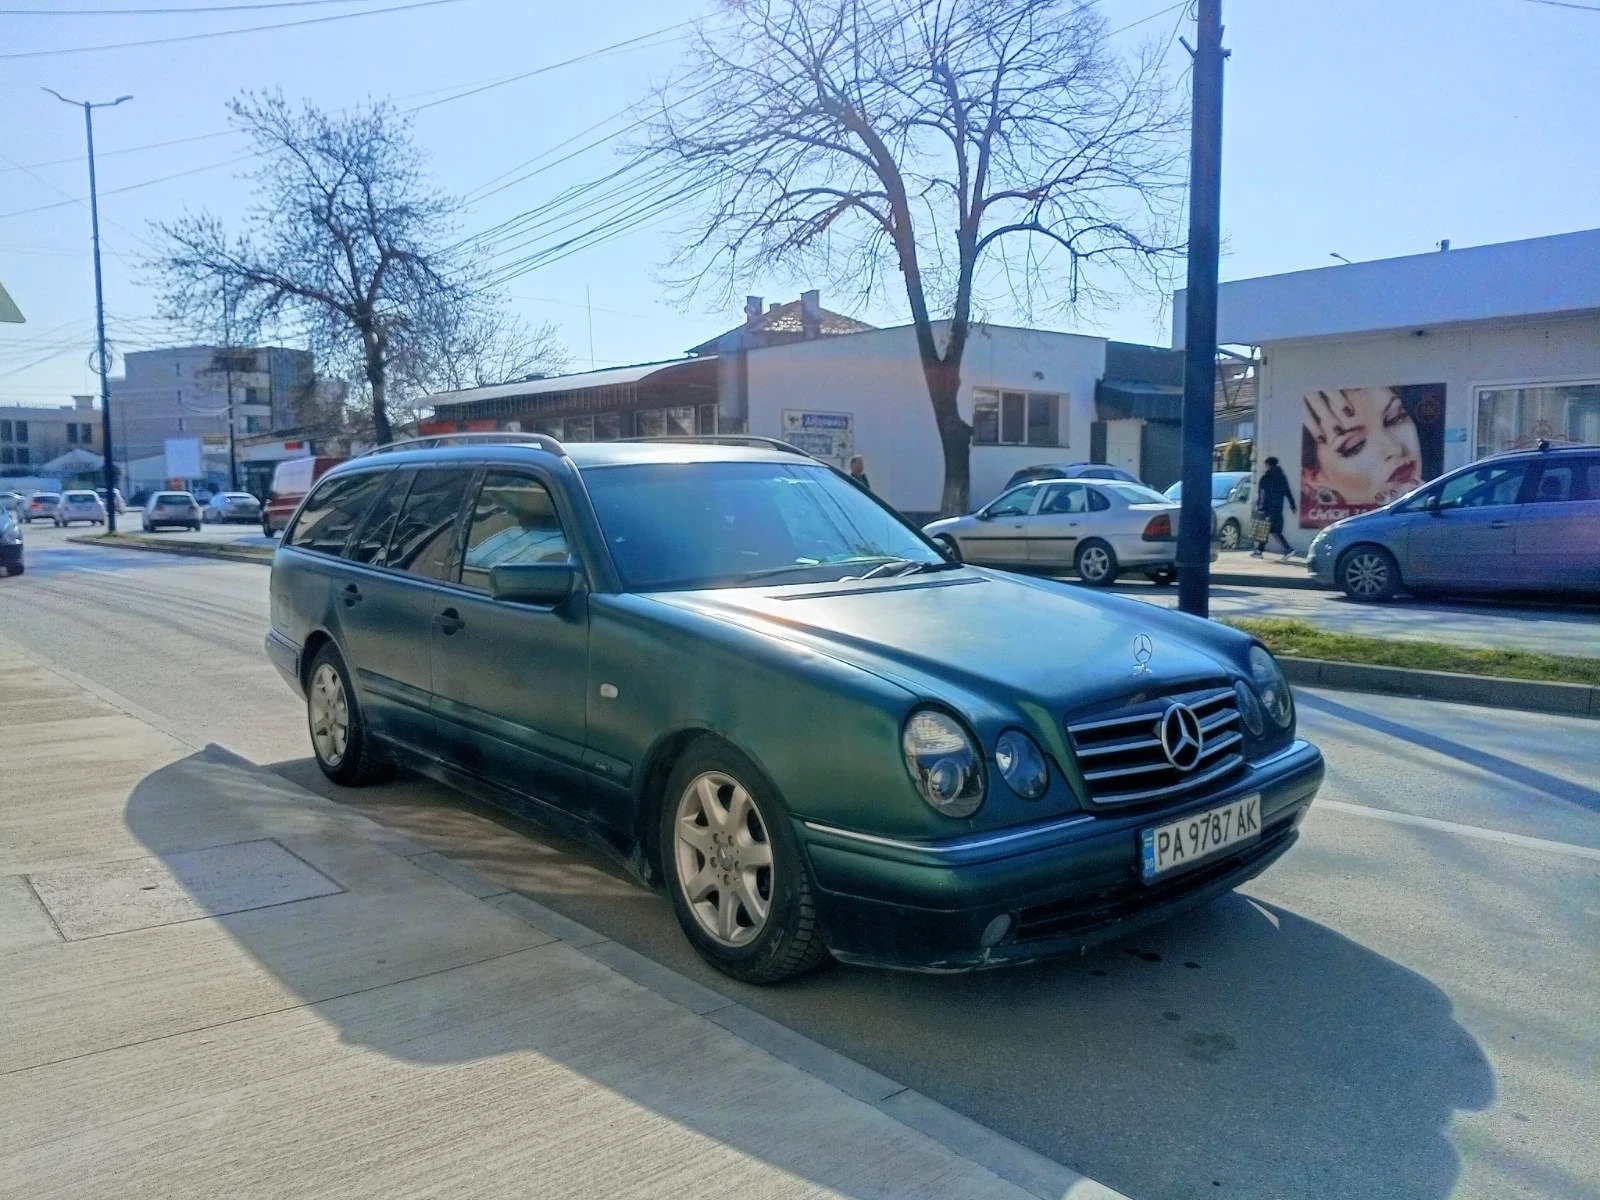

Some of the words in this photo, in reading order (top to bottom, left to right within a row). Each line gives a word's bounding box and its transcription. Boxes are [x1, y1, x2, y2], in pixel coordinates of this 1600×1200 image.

[1158, 828, 1184, 866] PA
[1189, 808, 1232, 854] 9787
[1237, 799, 1258, 836] AK
